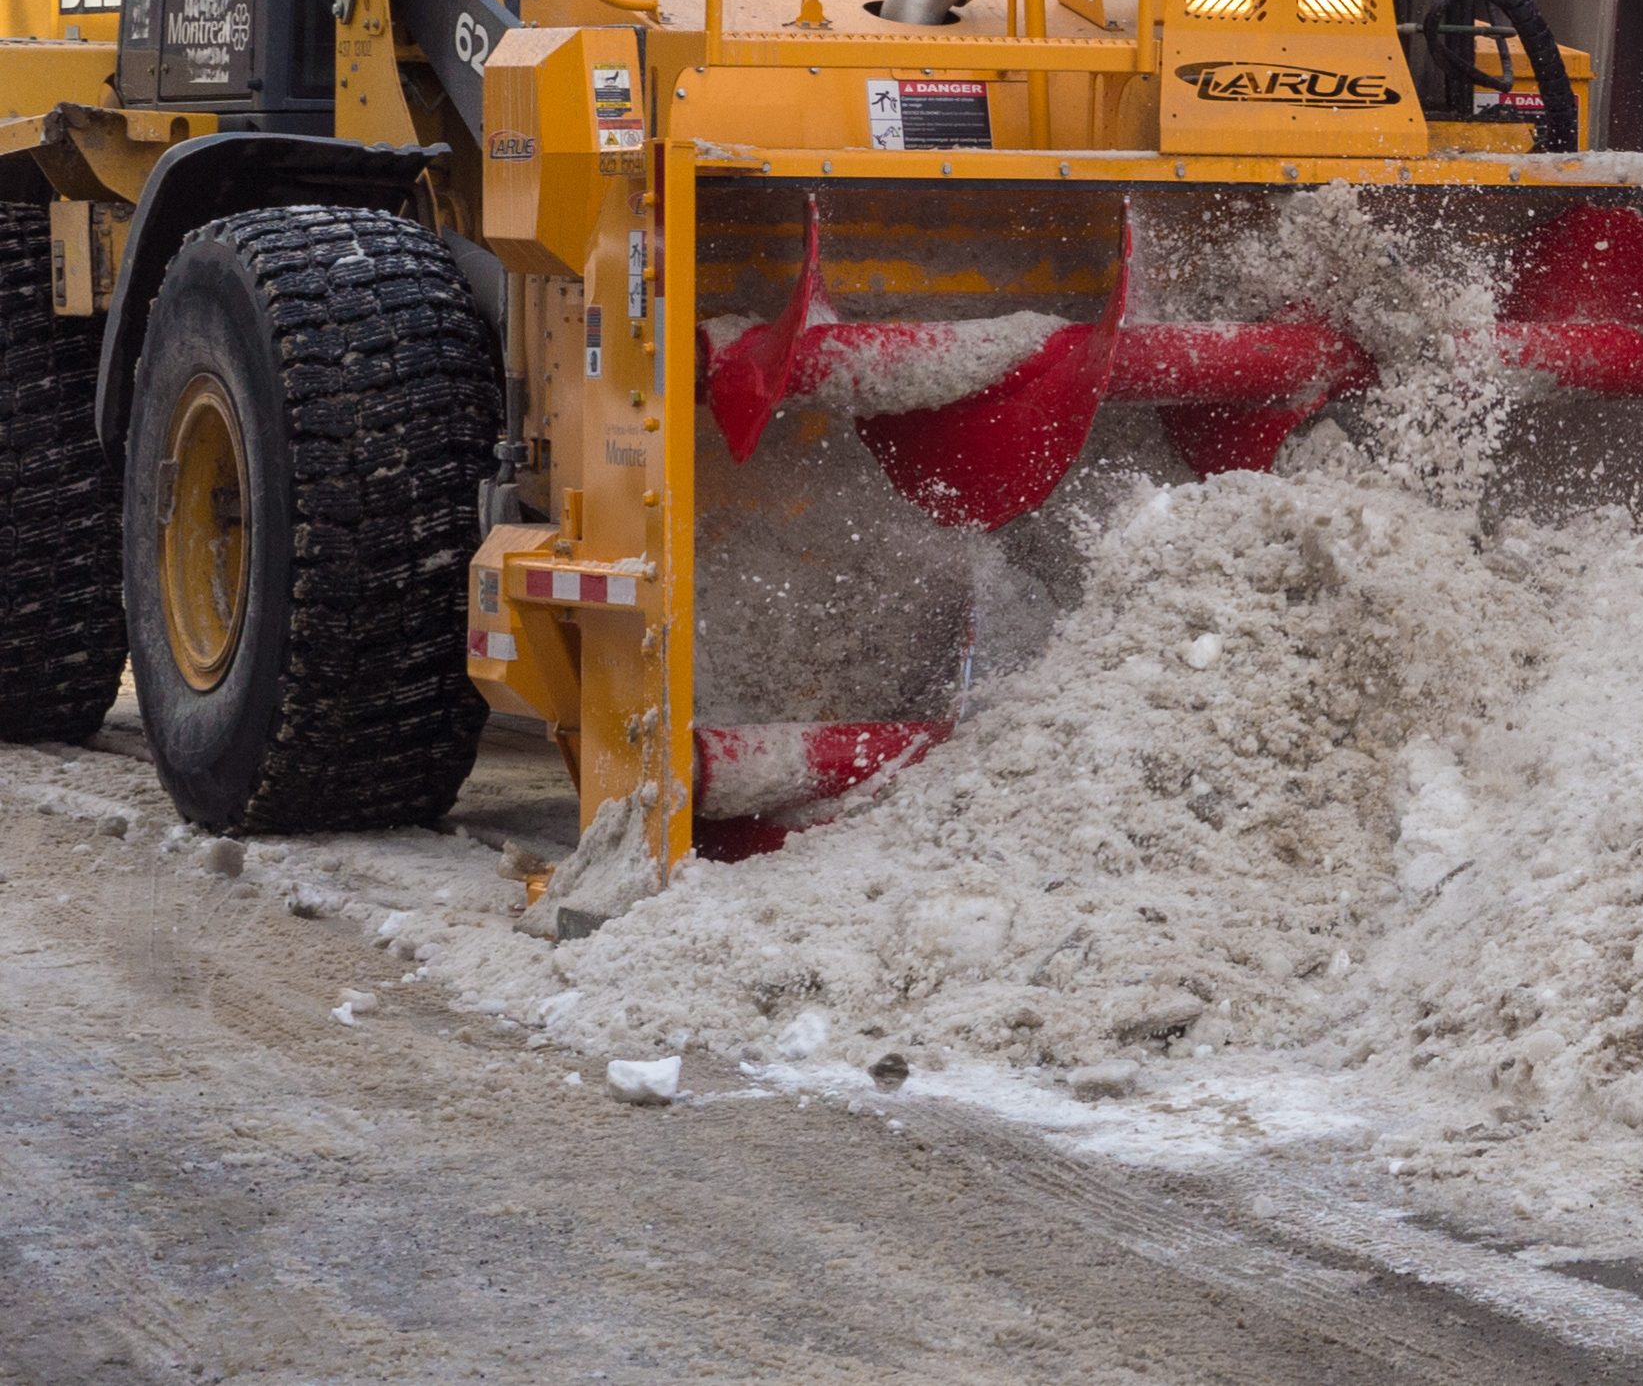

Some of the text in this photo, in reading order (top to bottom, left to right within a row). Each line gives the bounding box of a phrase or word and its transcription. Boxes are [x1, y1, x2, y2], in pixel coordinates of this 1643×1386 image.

[916, 83, 983, 94] DANGER
[1198, 69, 1390, 104] LARUE
[1514, 96, 1545, 107] DAN
[489, 137, 535, 160] LARUE
[605, 439, 647, 467] Montré
